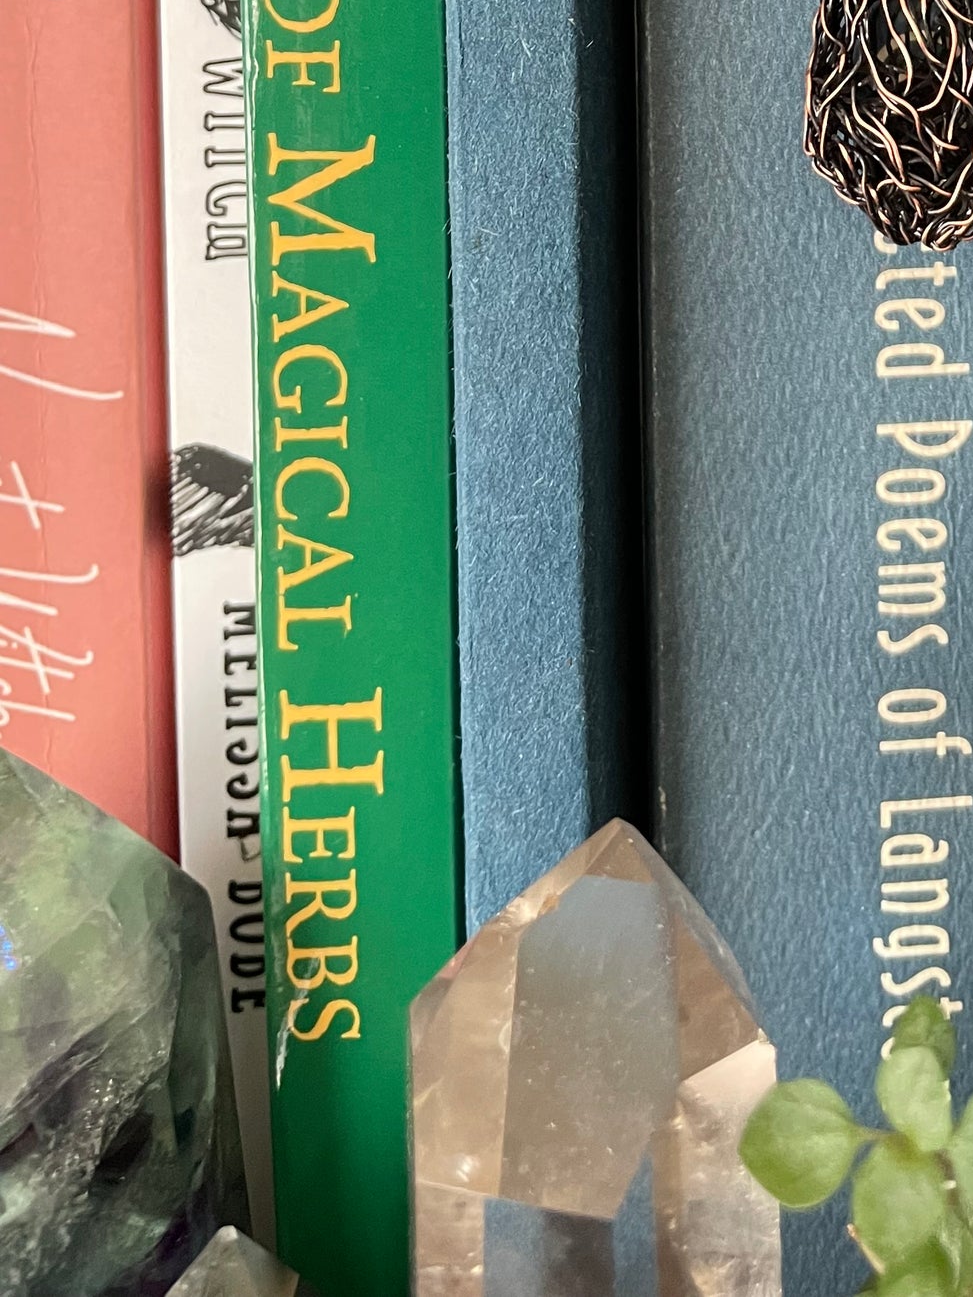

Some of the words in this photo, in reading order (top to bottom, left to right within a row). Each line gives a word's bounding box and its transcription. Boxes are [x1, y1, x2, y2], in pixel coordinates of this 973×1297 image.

[267, 132, 377, 652] MAGICAL
[876, 420, 973, 656] Poems
[878, 688, 973, 757] of
[279, 686, 385, 1042] HERBS
[873, 795, 973, 1060] Langst
